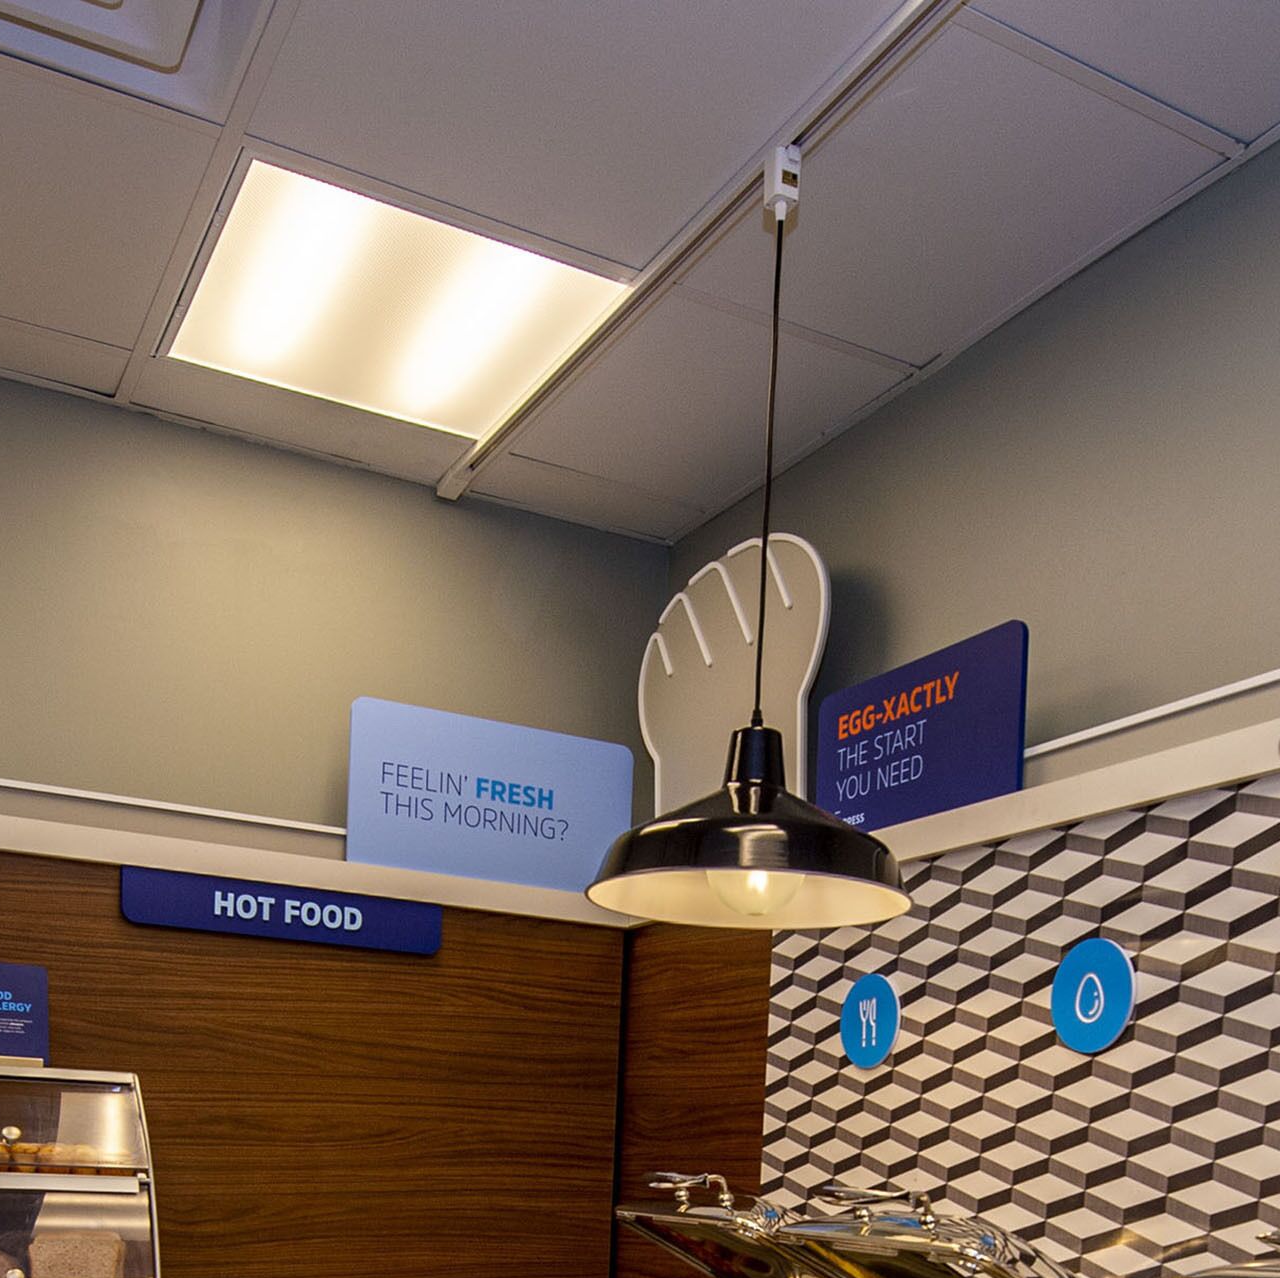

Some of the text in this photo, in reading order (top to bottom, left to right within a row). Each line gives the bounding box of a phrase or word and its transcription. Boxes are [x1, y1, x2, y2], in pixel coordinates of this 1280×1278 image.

[838, 671, 960, 740] EGG-XACTLY
[837, 719, 927, 772] THE START
[476, 776, 554, 811] FRESH
[835, 754, 924, 802] YOU NEED
[380, 790, 569, 842] THIS MORNING?
[213, 889, 363, 932] HOT FOOD
